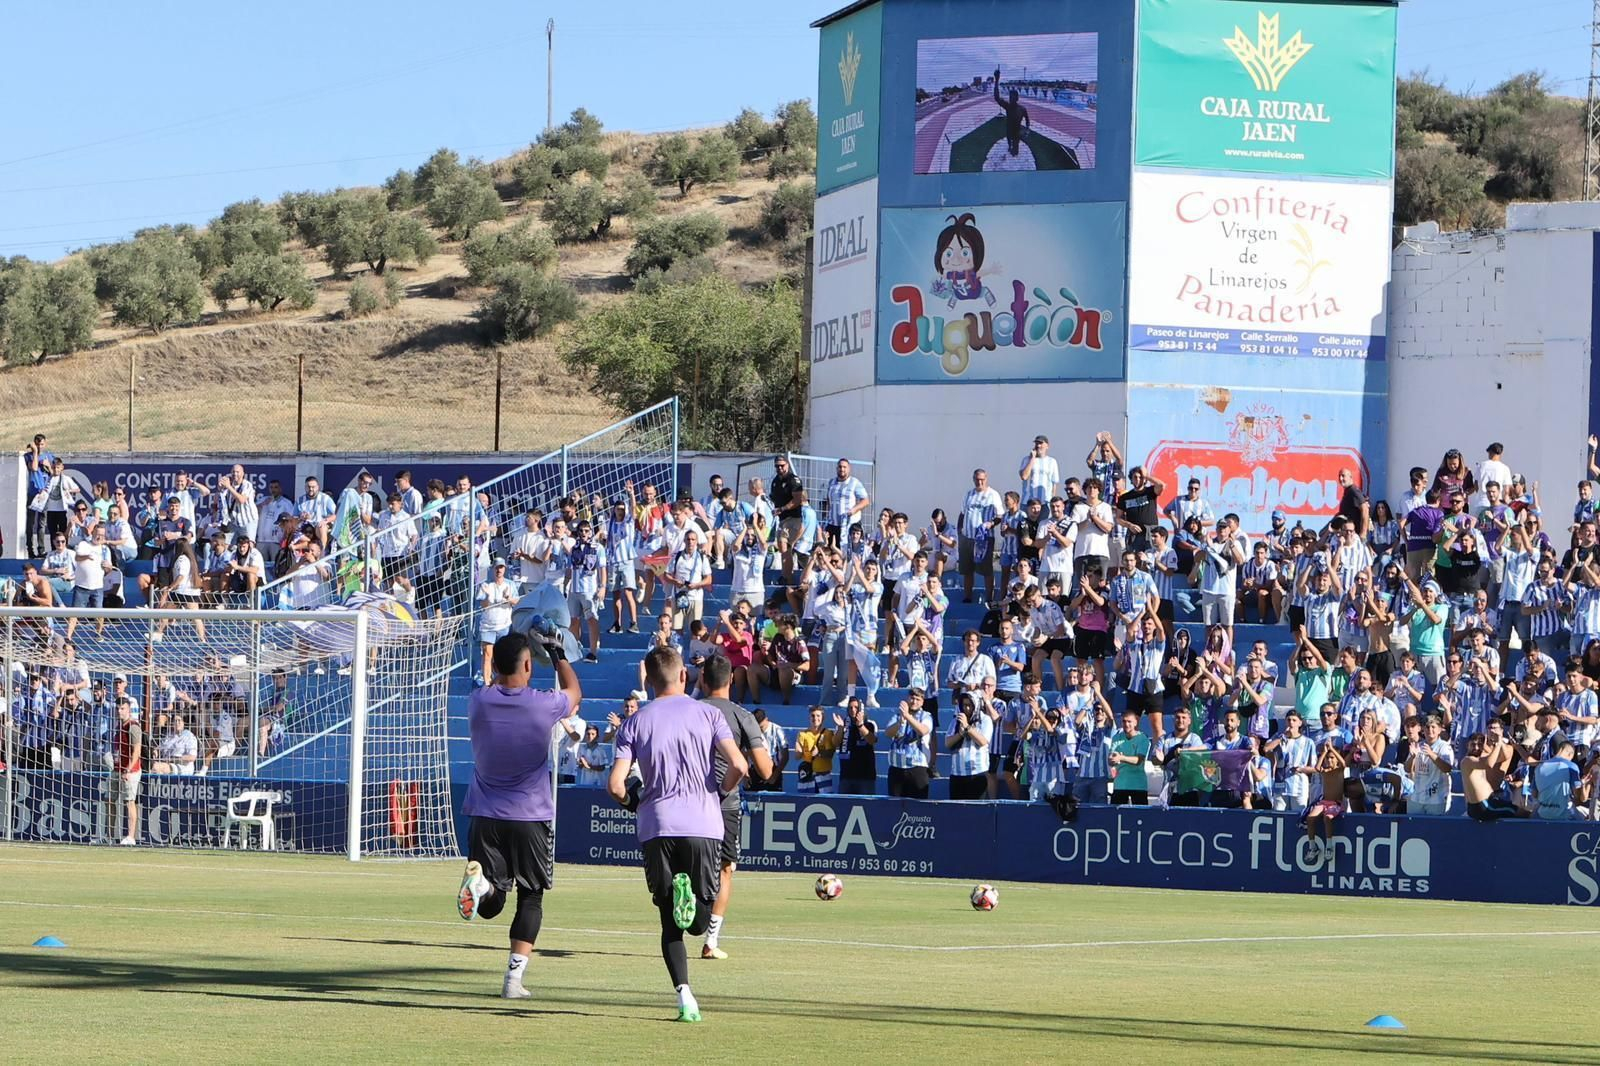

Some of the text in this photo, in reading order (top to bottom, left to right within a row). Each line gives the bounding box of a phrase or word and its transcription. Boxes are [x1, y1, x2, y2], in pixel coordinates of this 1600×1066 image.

[1200, 96, 1330, 123] CAJA RURAL
[1242, 121, 1297, 143] JAEN
[1224, 147, 1305, 160] www.ruralvia.com
[1176, 185, 1349, 234] Confitería
[818, 215, 868, 267] IDEAL
[1220, 221, 1277, 244] Virgen
[1238, 247, 1258, 264] de
[1209, 267, 1287, 290] Linarejos
[1176, 274, 1341, 324] Panadería
[813, 312, 864, 364] IDEAL
[1147, 327, 1229, 341] Paseo de Linarejos
[1241, 331, 1299, 343] Calle Serrallo
[1318, 335, 1362, 346] Calle Jaén
[1193, 342, 1203, 351] 15
[1205, 342, 1217, 351] 44
[1240, 344, 1298, 355] 953 81 04 16
[1311, 347, 1328, 357] 953
[1331, 348, 1342, 357] 00
[115, 472, 267, 490] CONSTCCES
[1174, 463, 1340, 511] Mahou
[150, 778, 214, 804] Montajes
[590, 805, 638, 820] Panade
[590, 820, 635, 834] Bollería
[1053, 814, 1234, 876] opticas
[1249, 816, 1431, 877] florida
[784, 855, 792, 867] 8
[803, 857, 848, 870] Linares
[858, 858, 880, 871] 953
[883, 859, 898, 871] 60
[901, 860, 916, 873] 26
[919, 861, 934, 873] 91
[1311, 874, 1430, 893] LINARES
